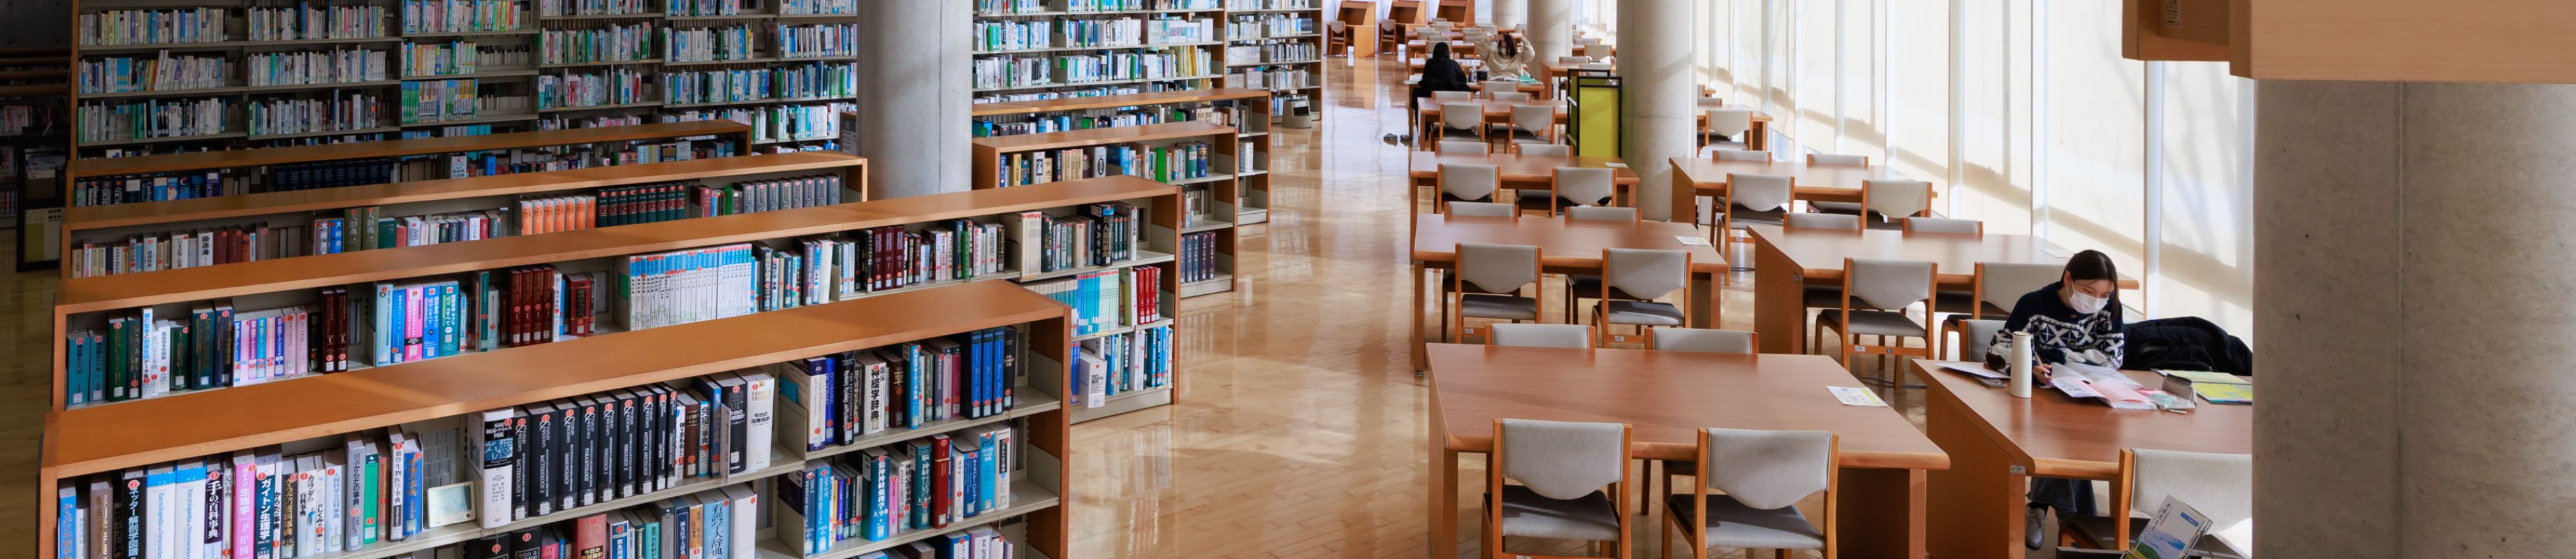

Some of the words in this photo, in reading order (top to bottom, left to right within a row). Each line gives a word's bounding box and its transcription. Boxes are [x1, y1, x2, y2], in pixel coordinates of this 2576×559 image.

[728, 401, 744, 410] 2017
[207, 480, 222, 539] 手の百科事典
[259, 478, 272, 540] ガイトン生理学
